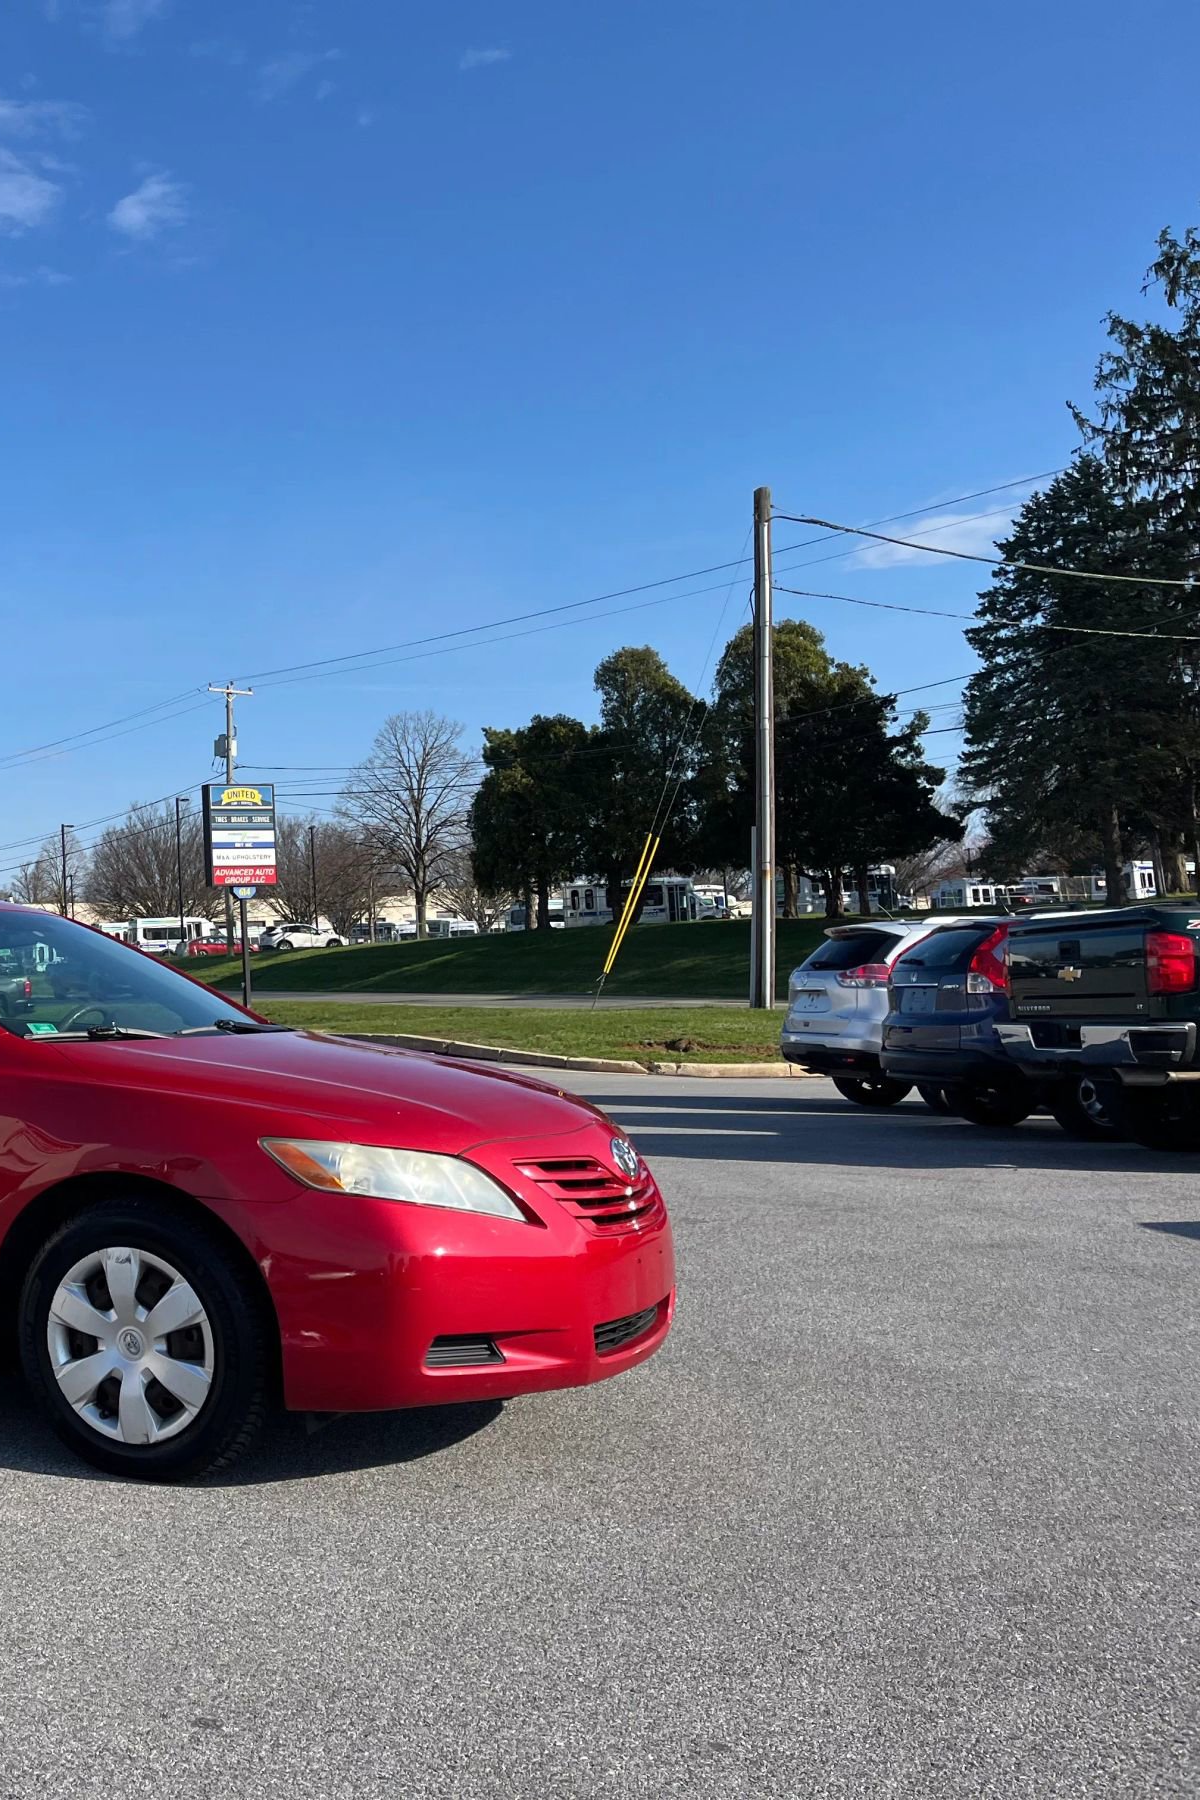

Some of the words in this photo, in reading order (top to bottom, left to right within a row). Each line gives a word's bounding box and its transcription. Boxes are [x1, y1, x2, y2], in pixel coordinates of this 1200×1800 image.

[227, 790, 256, 799] UNITED
[214, 868, 254, 876] ADVANCED
[255, 868, 275, 876] AUTO
[224, 876, 251, 884] GROUP
[251, 876, 266, 884] LLC
